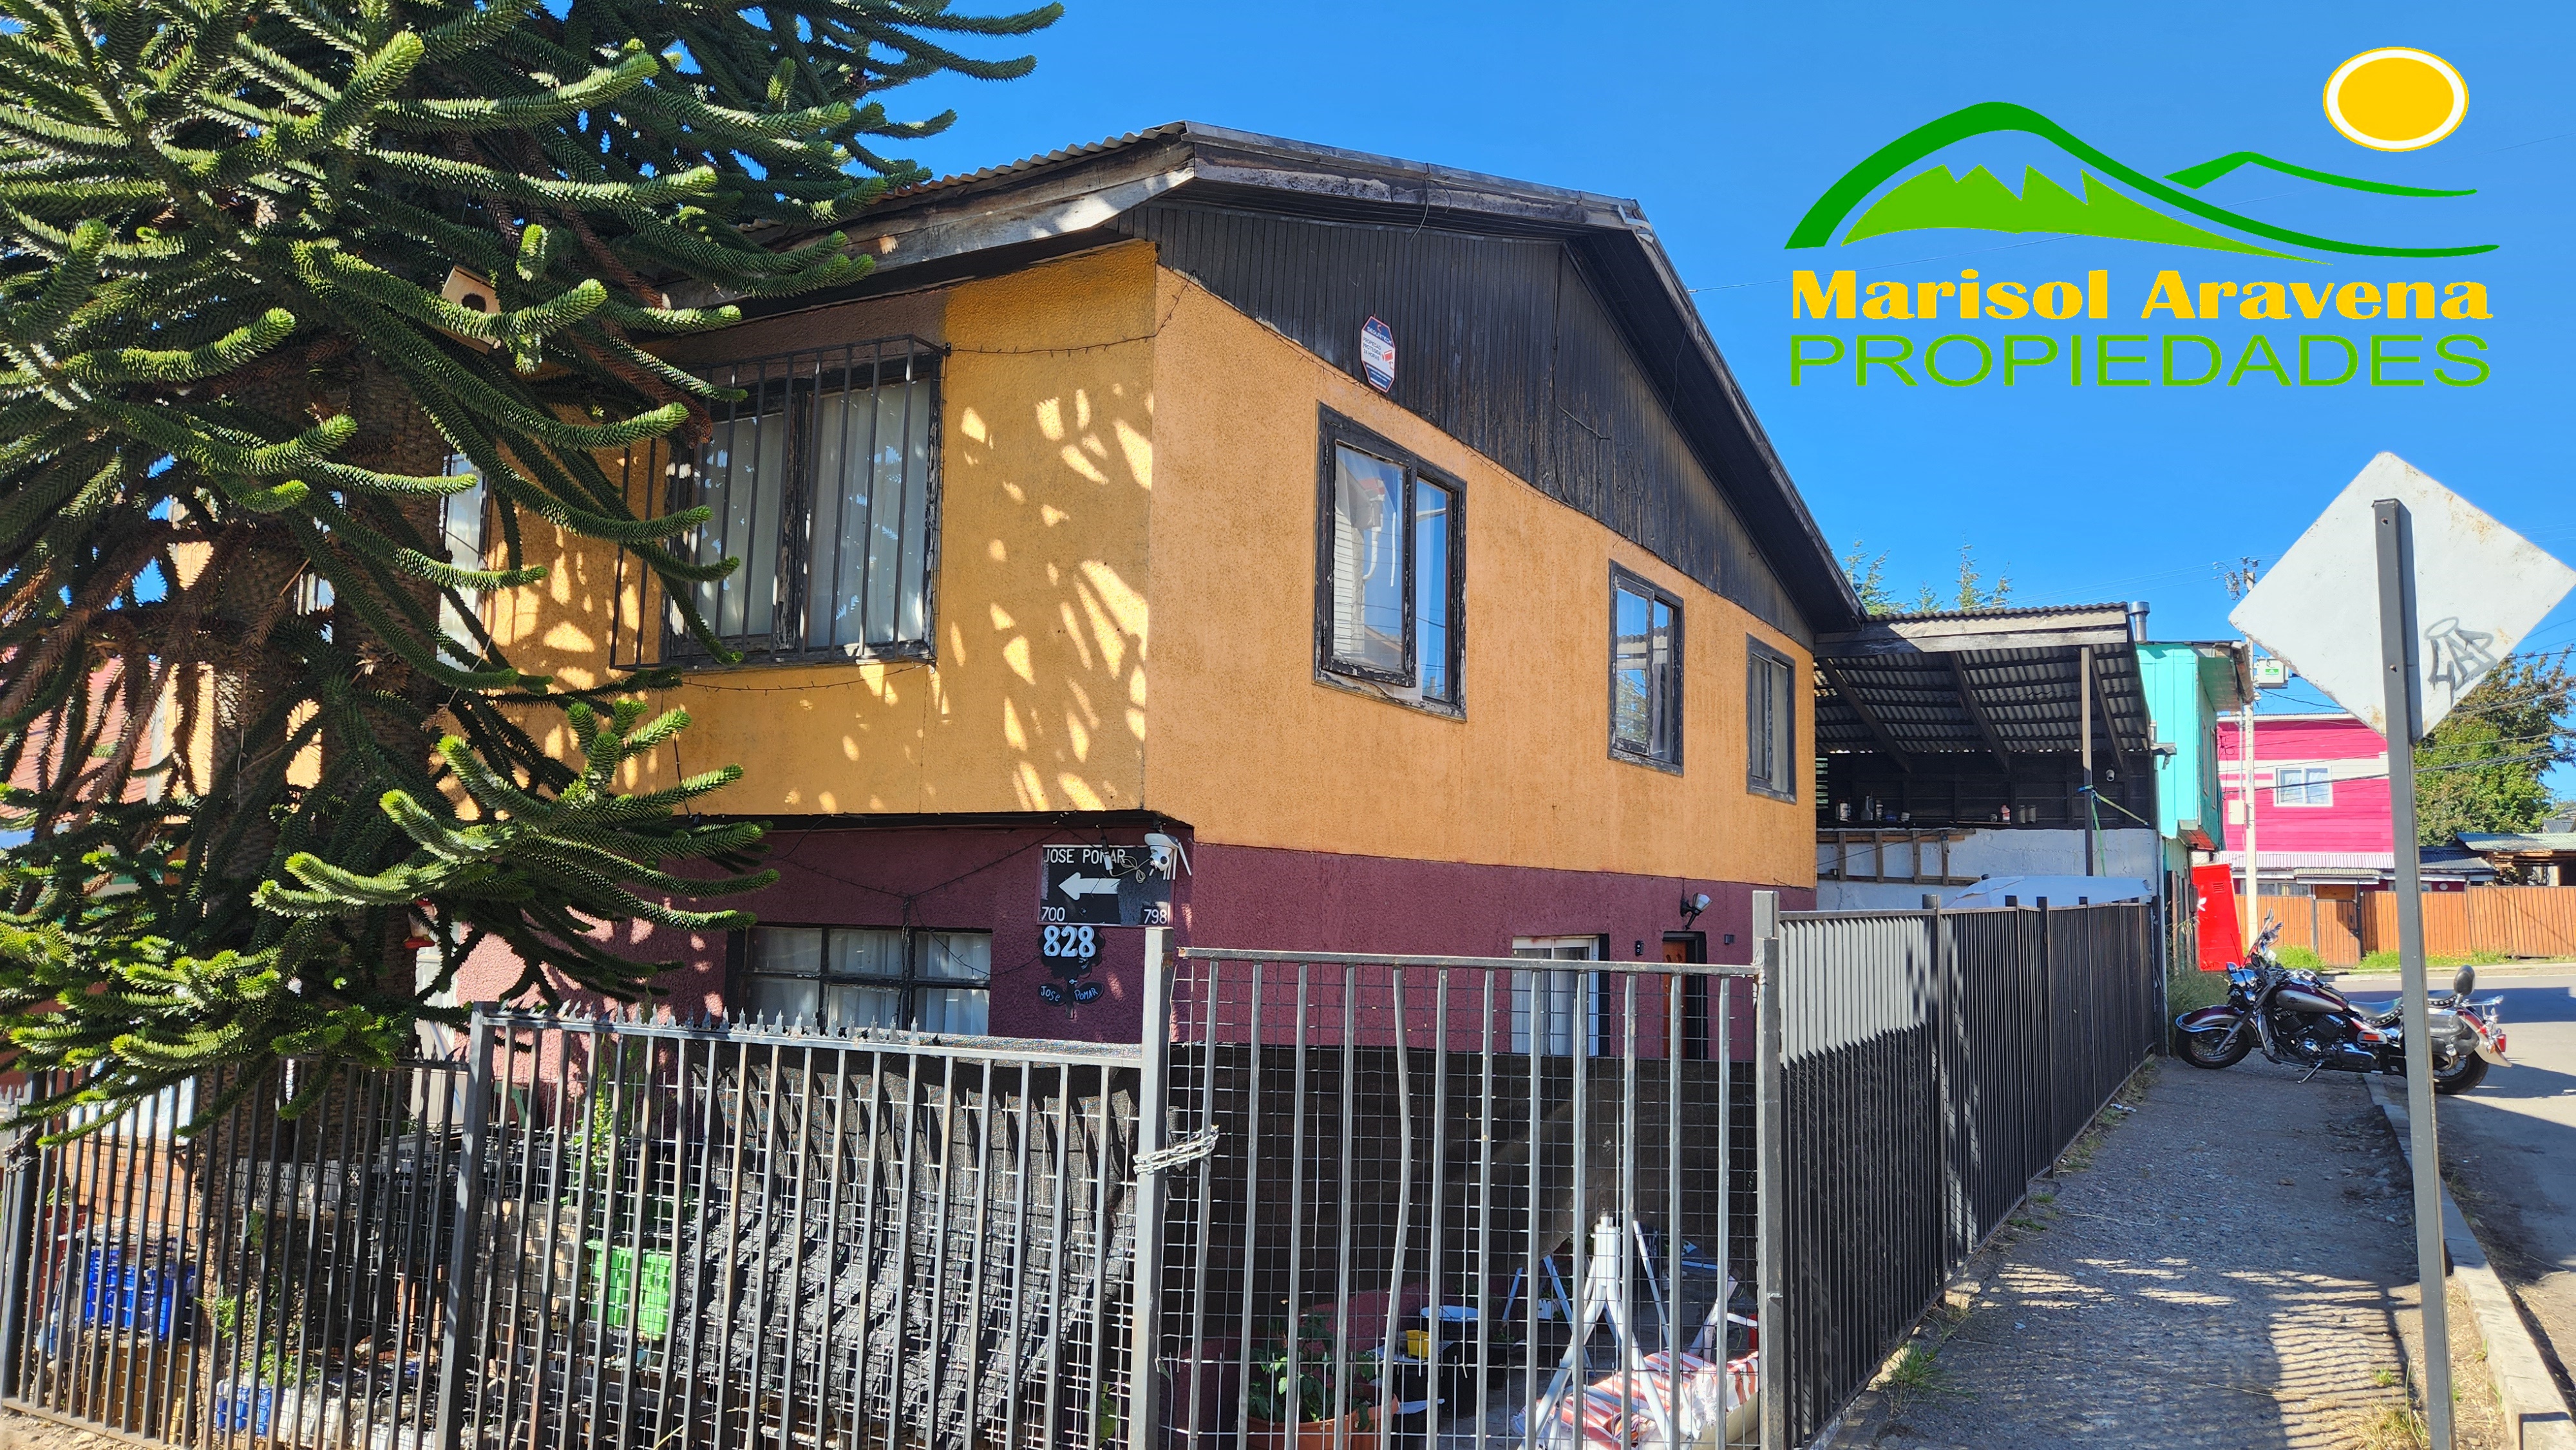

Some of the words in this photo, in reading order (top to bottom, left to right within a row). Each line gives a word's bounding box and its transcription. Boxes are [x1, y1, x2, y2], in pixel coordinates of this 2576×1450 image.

[1043, 849, 1075, 864] JOSE
[1041, 906, 1065, 922] 700
[1144, 909, 1168, 925] 798
[1043, 925, 1096, 957] 828
[1074, 987, 1099, 1001] POMAR
